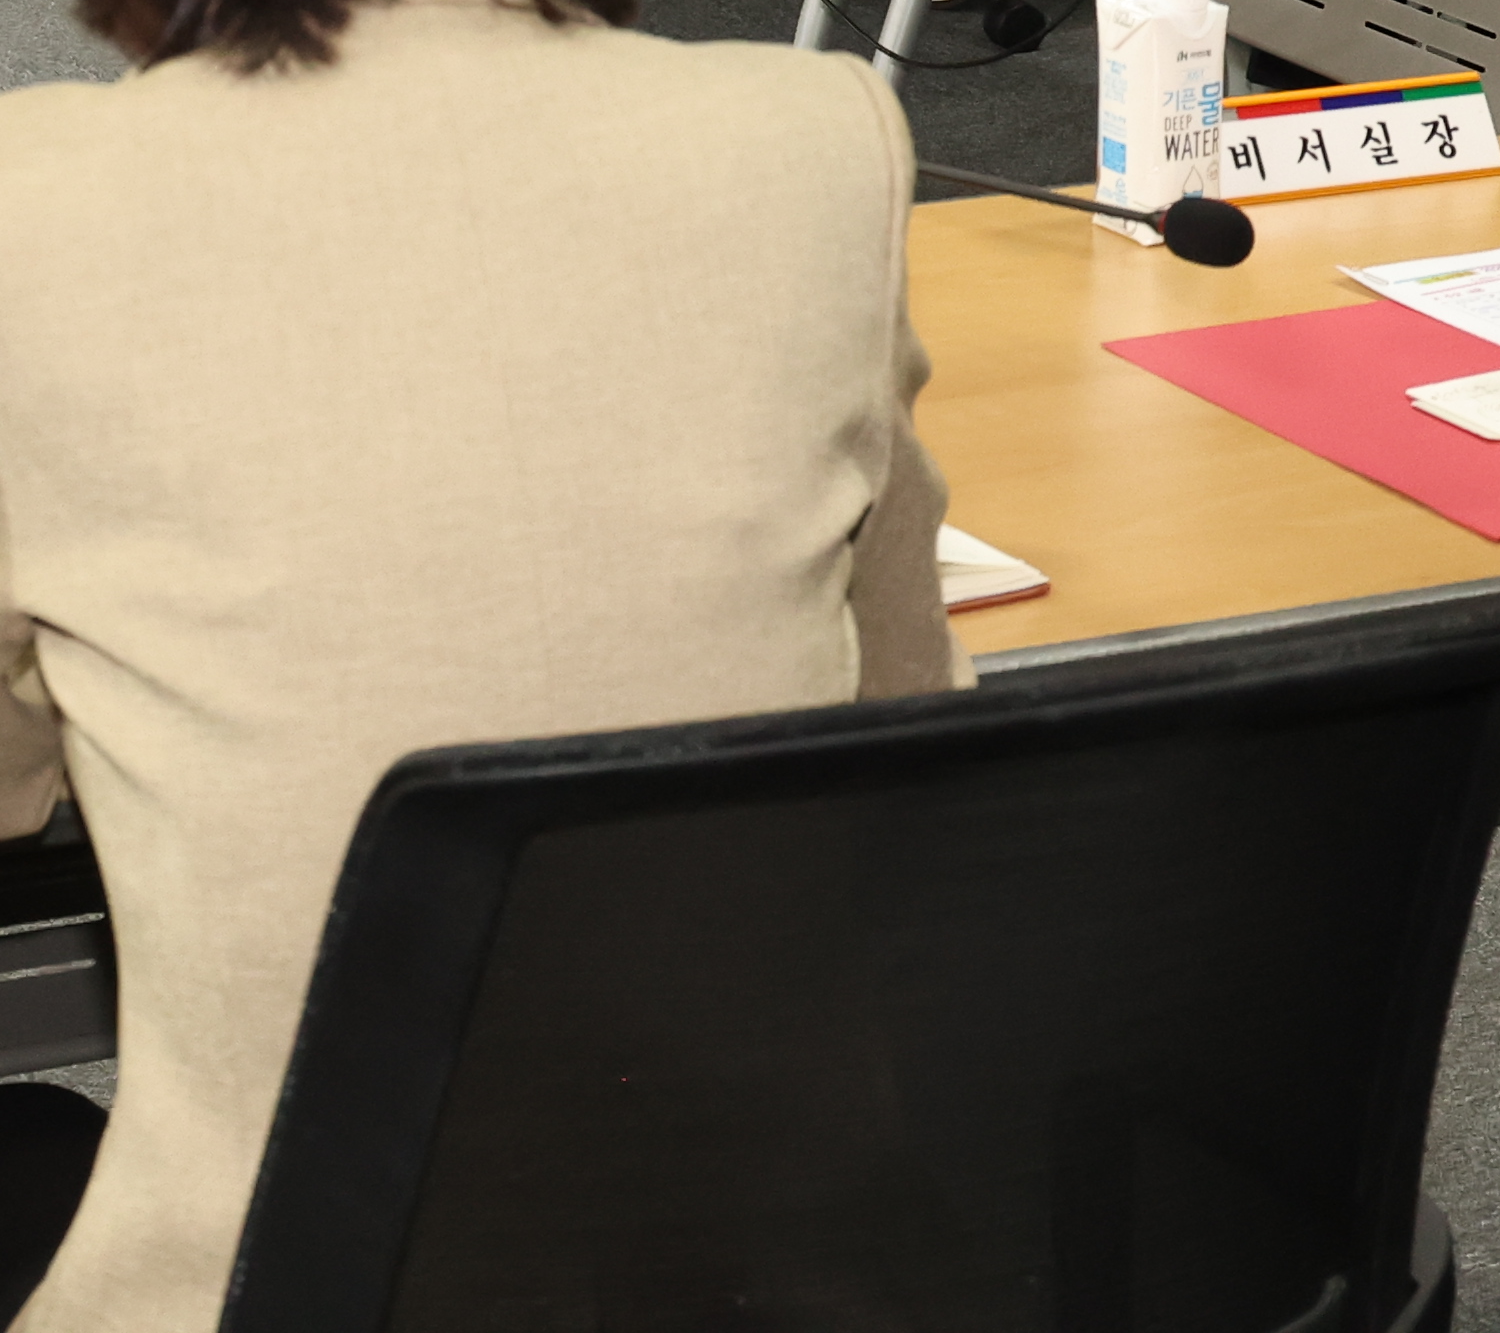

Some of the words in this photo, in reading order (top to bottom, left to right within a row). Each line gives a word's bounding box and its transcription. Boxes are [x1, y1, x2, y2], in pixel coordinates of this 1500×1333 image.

[1164, 114, 1193, 133] DEEP
[1164, 127, 1220, 163] WATER
[1227, 114, 1460, 182] 비서실장
